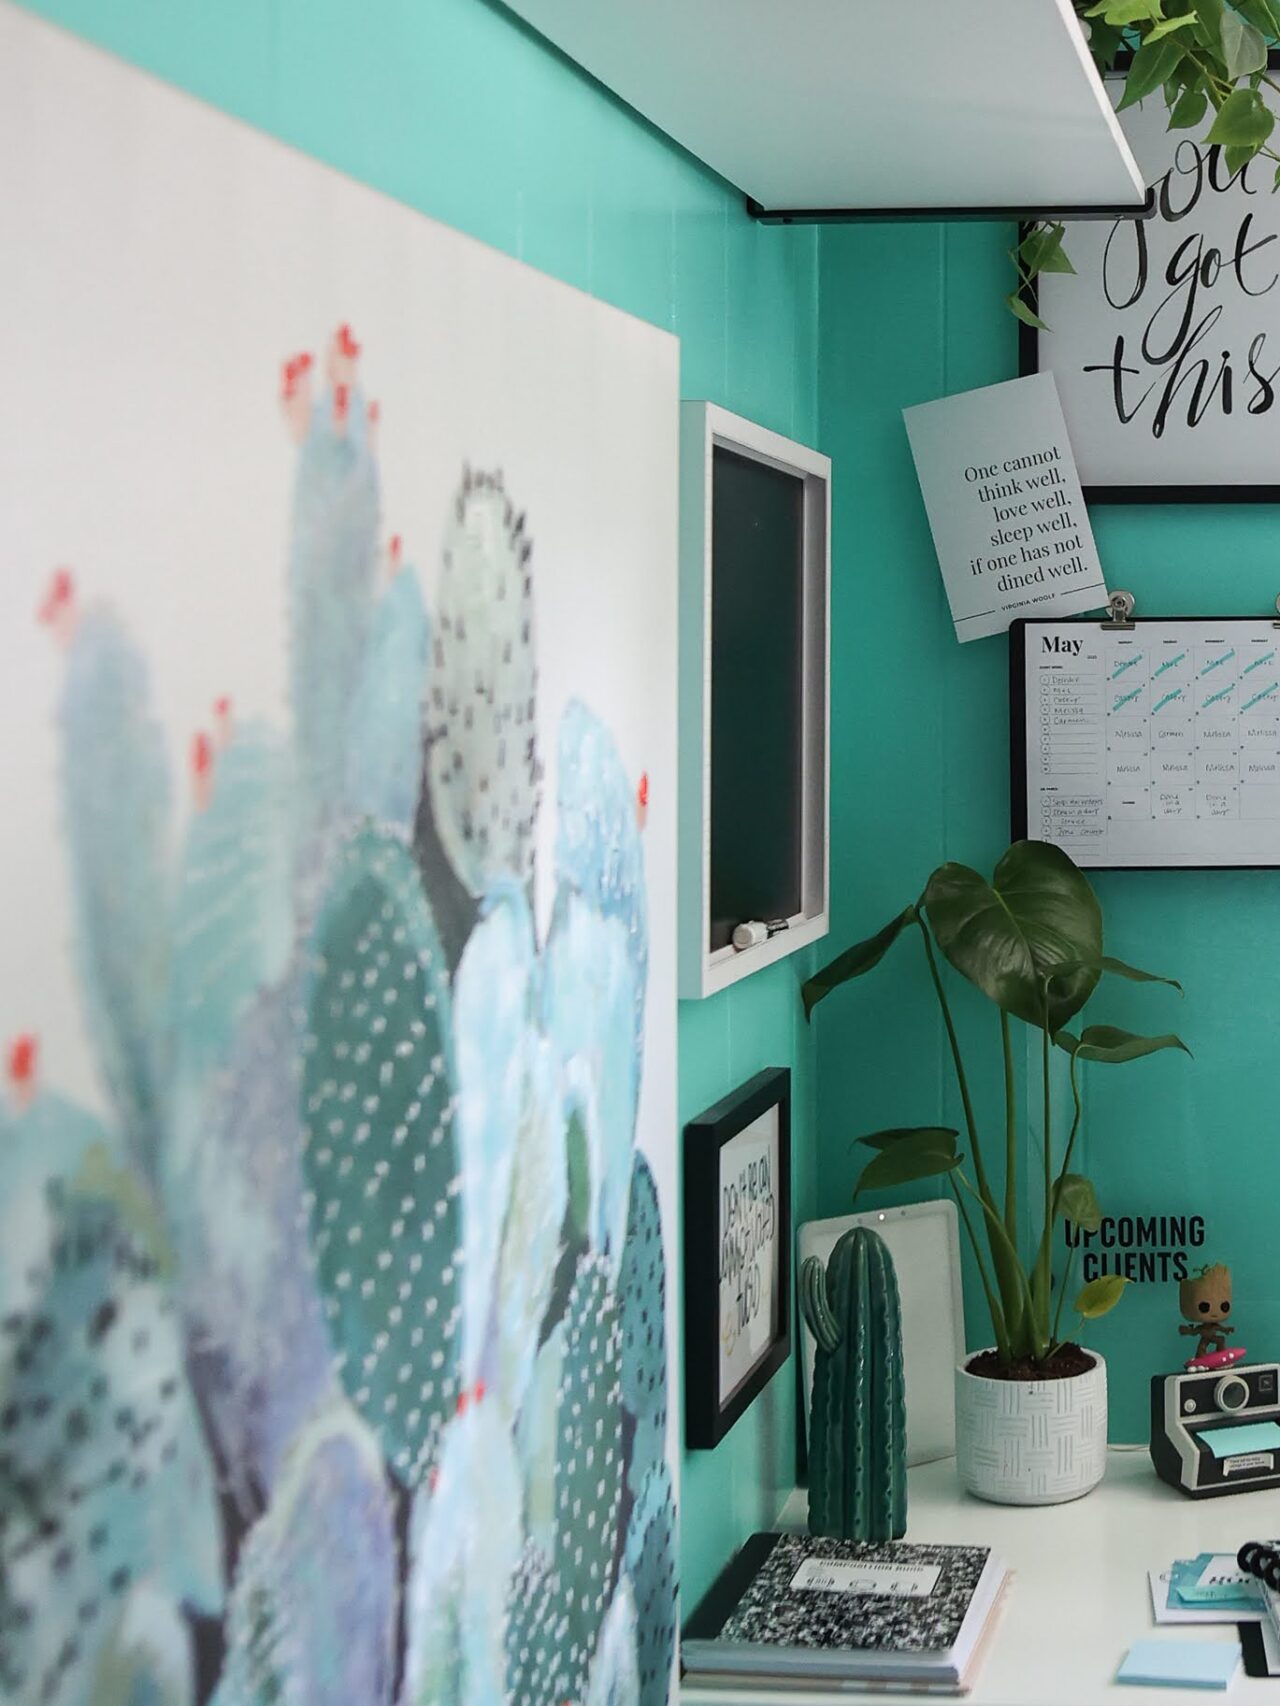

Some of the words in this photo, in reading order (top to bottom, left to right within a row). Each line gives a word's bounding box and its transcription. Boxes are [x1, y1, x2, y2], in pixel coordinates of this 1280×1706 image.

[1141, 213, 1279, 366] got
[964, 462, 999, 483] One
[1003, 445, 1062, 473] cannot
[978, 477, 1023, 503] think
[1026, 467, 1067, 490] well,
[993, 499, 1028, 523] love
[1032, 489, 1072, 512] well,
[990, 524, 1034, 548] sleep
[1037, 511, 1078, 534] well,
[970, 558, 985, 576] if
[987, 553, 1018, 572] one
[1021, 545, 1051, 563] has
[1054, 534, 1084, 556] not
[997, 566, 1045, 592] dined
[1048, 556, 1089, 579] well.
[1001, 598, 1032, 612] VIRGINIA
[1031, 592, 1057, 605] WOOLF
[1041, 636, 1084, 656] May
[1064, 1215, 1205, 1248] UPCOMING
[1083, 1251, 1188, 1283] CLIENTS
